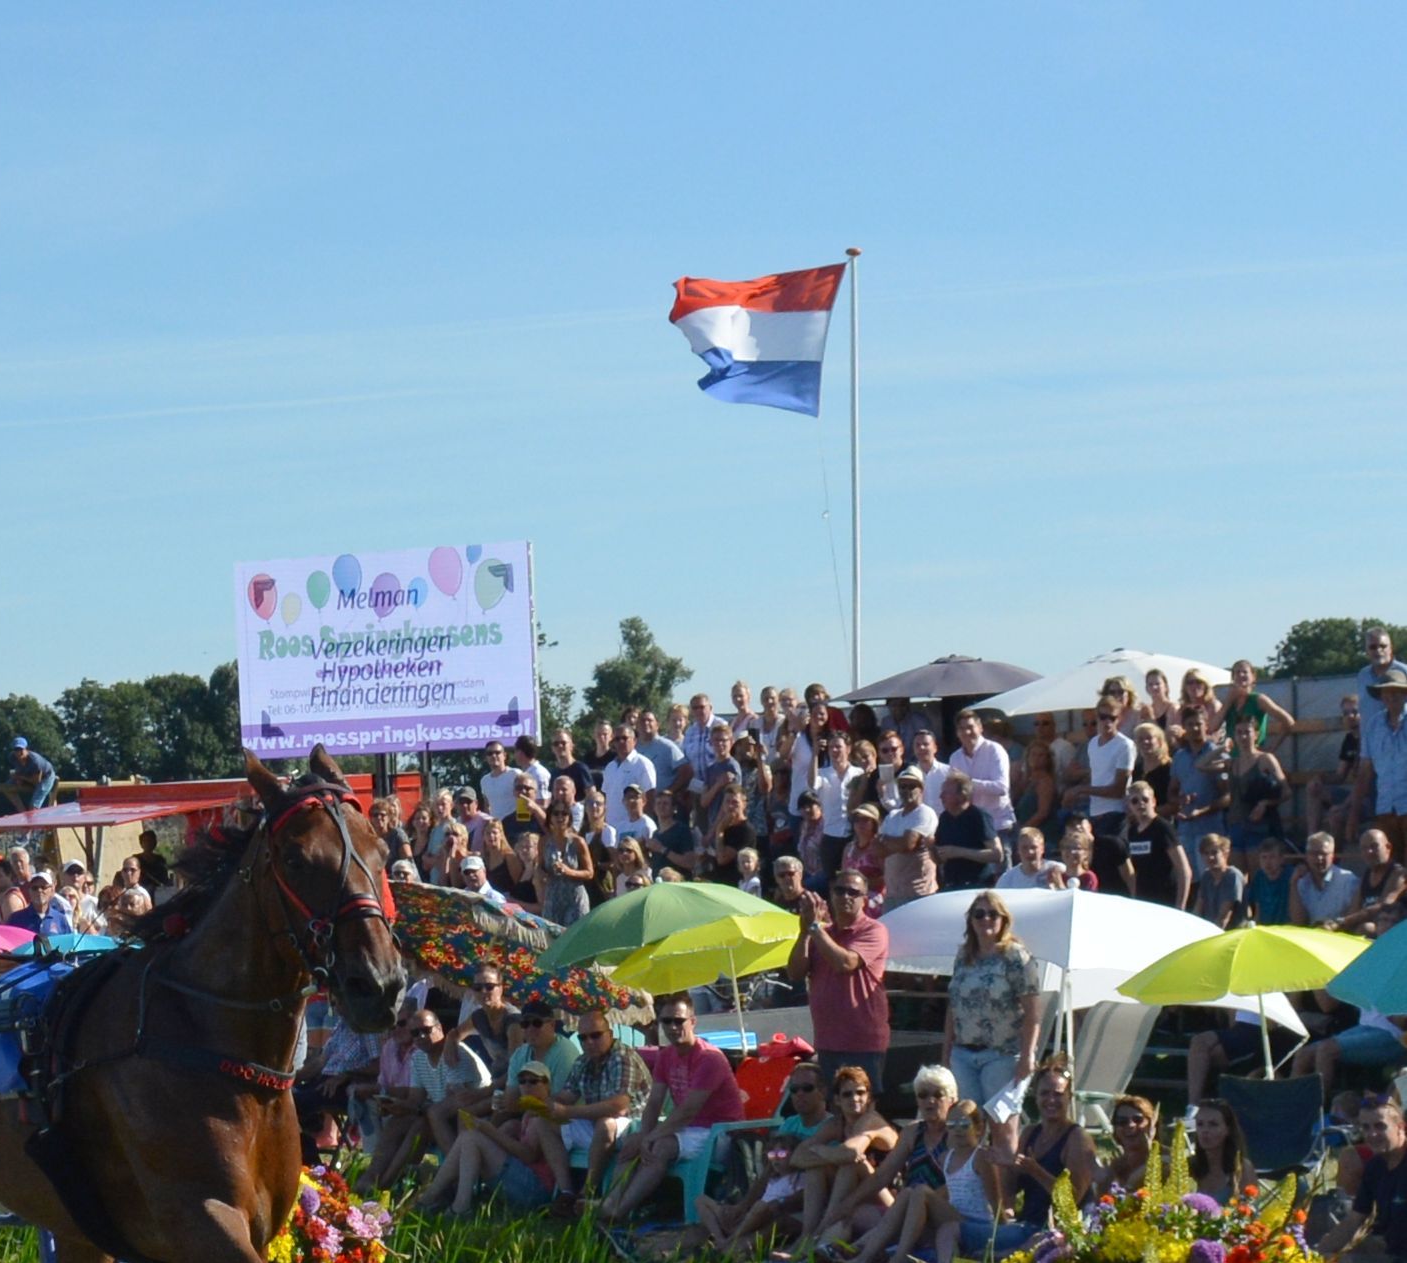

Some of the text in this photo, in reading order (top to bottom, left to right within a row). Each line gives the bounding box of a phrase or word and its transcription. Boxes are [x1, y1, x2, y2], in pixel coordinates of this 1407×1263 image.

[337, 587, 418, 610] Melman
[257, 620, 503, 662] Roos Springkussens
[311, 632, 451, 661] Verzekeringen
[322, 657, 442, 689] Hypotheken
[310, 680, 455, 708] Financieringen
[242, 718, 531, 751] www.roosspringkussens.nl
